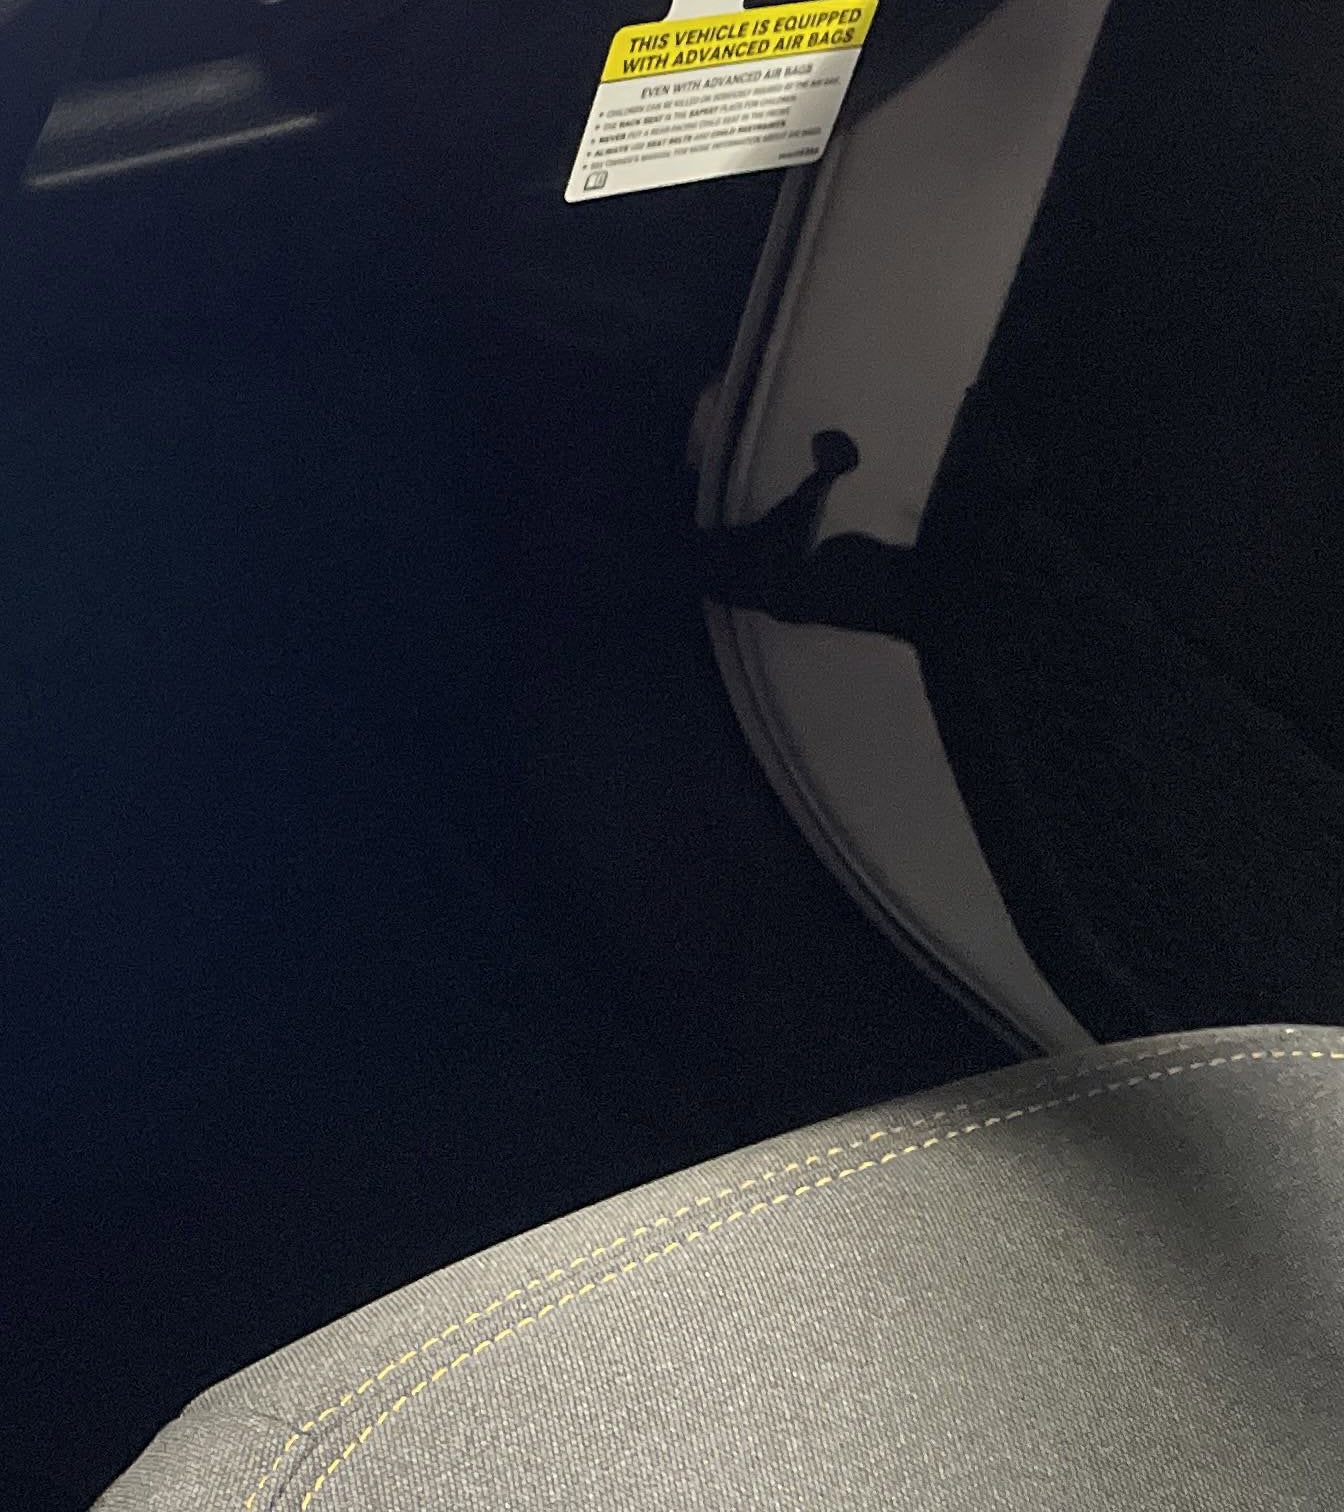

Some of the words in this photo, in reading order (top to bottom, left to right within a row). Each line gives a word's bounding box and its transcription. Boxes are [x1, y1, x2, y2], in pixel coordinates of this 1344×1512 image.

[619, 53, 669, 74] WITH
[671, 39, 771, 66] ADVANCED
[772, 34, 805, 52] AIR
[806, 26, 856, 47] BAGS
[626, 33, 670, 53] THIS
[672, 22, 750, 47] VEHICLE
[751, 19, 770, 36] IS
[772, 6, 864, 33] EQUIPPED
[639, 83, 670, 98] EVEN
[671, 79, 702, 94] WITH
[702, 70, 762, 89] ADVANCED
[763, 67, 783, 79] AIR
